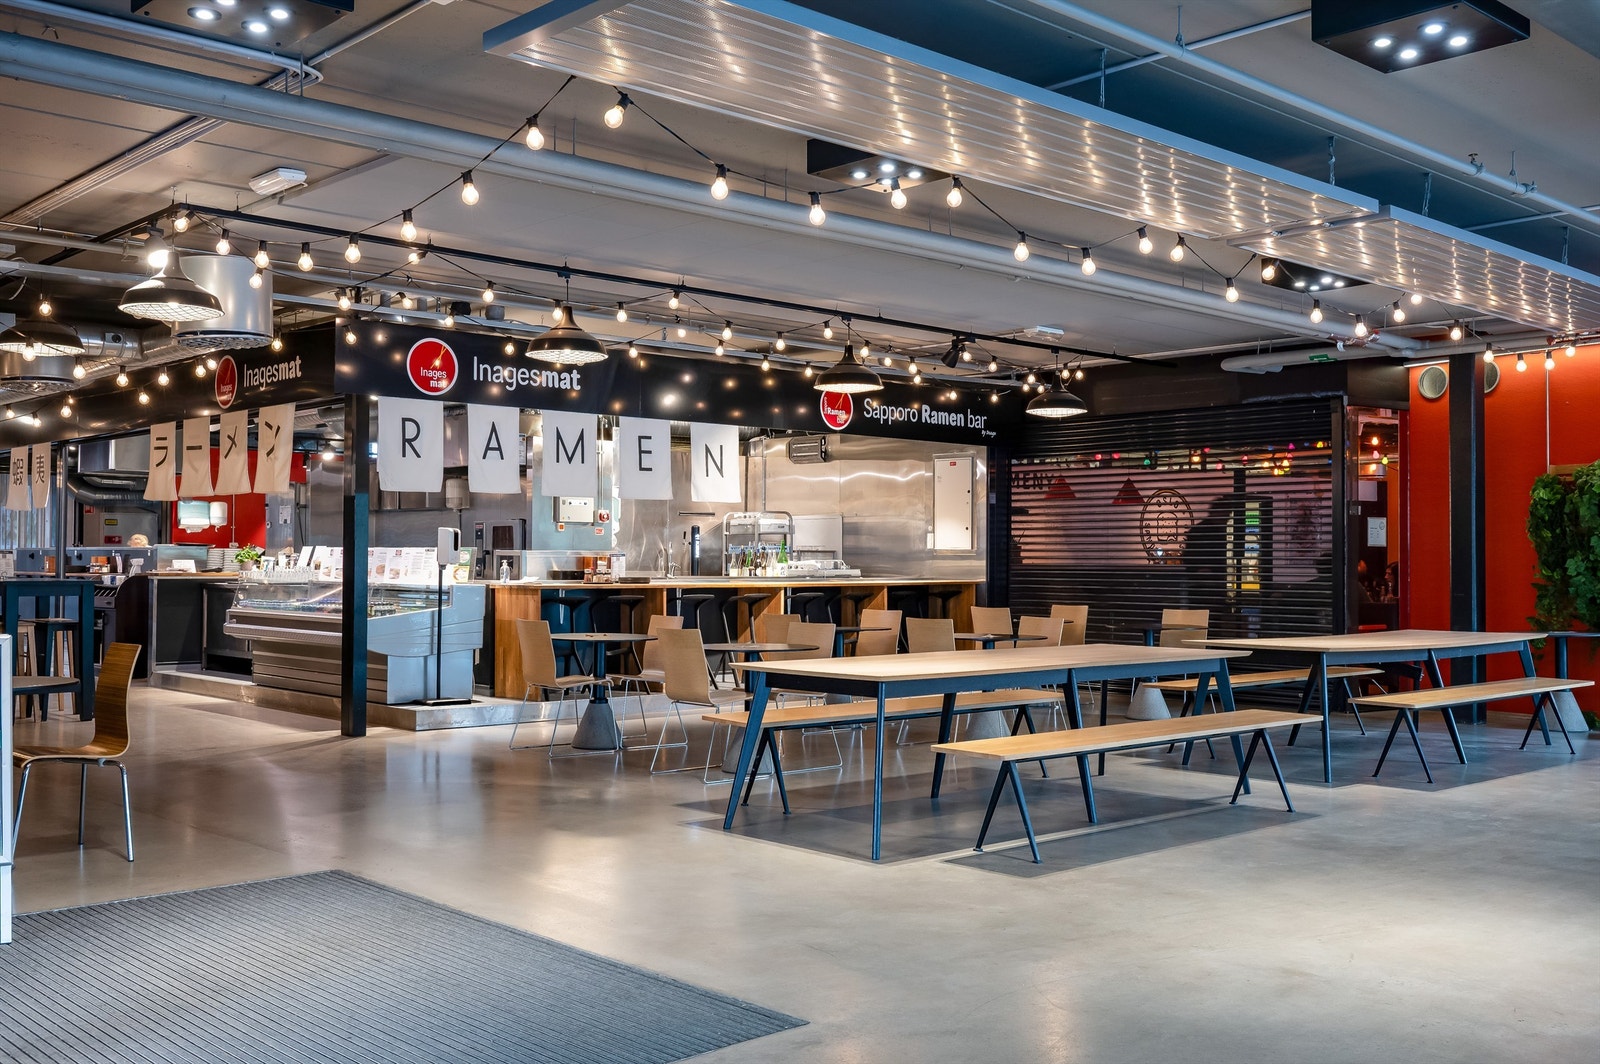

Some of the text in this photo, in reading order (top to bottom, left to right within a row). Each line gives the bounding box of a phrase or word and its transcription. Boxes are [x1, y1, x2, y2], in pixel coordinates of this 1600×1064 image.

[244, 355, 302, 391] Inagesmat
[420, 366, 447, 380] Inages
[473, 355, 582, 391] Inagesmat
[827, 407, 846, 417] Ramen
[863, 397, 988, 429] Sapporo Ramen bar
